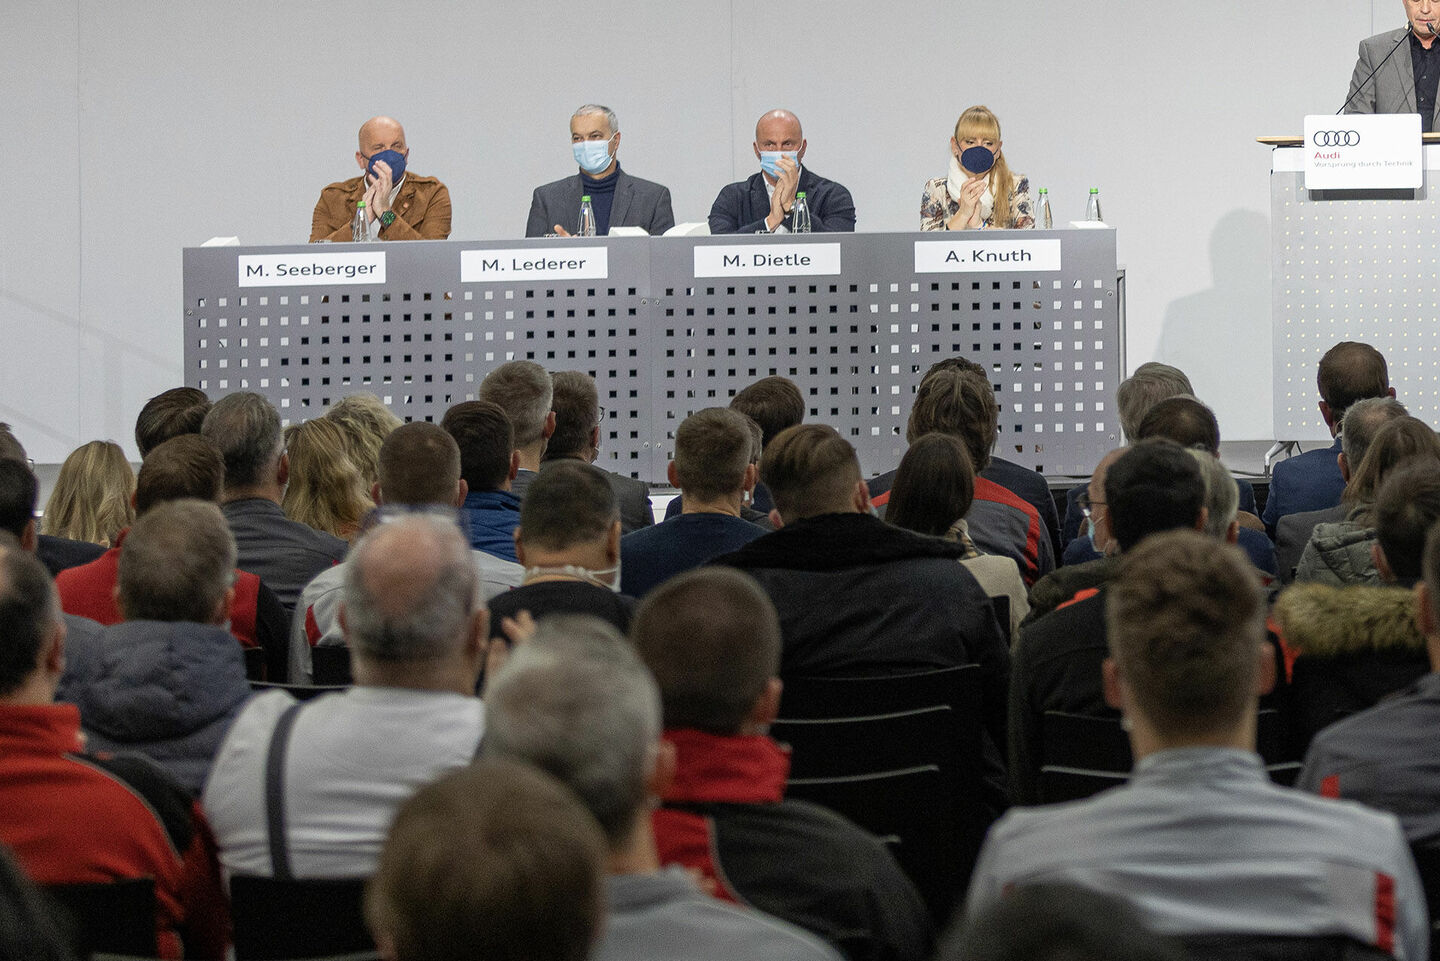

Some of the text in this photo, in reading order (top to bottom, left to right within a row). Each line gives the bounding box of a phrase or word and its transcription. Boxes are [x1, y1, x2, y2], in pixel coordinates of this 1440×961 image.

[1314, 151, 1341, 160] Audi
[723, 253, 811, 268] M. Dietle
[944, 249, 1032, 263] A. Knuth
[246, 262, 377, 279] M. Seeberger
[482, 257, 587, 272] M. Lederer
